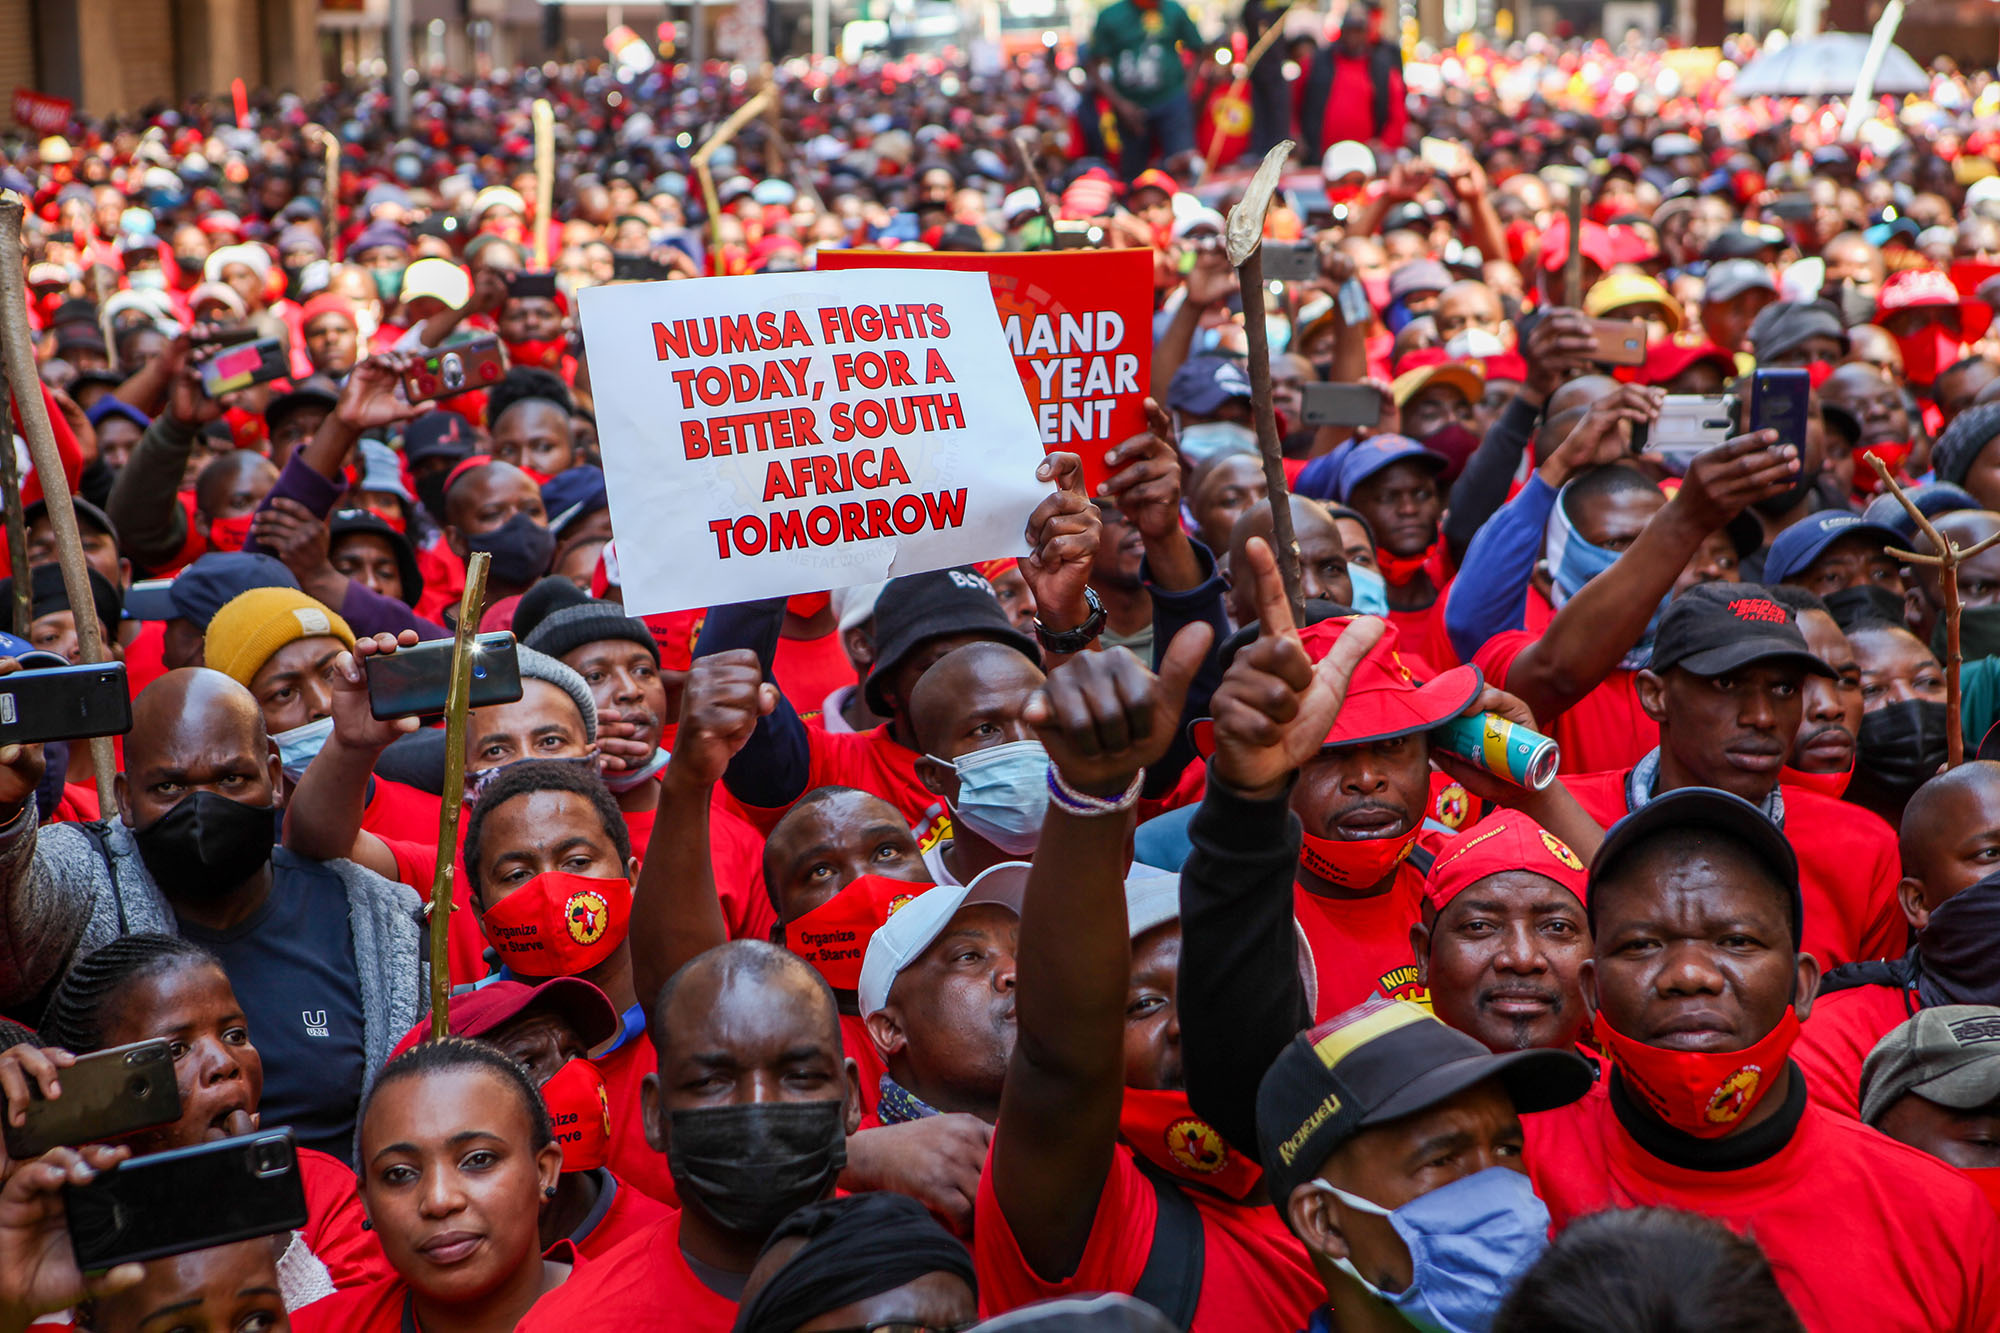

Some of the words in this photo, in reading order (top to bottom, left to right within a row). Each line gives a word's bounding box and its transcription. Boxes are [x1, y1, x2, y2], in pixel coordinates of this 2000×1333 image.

[651, 310, 814, 361] NUMSA
[818, 303, 951, 345] FIGHTS
[671, 357, 824, 409] TODAY,
[833, 350, 918, 392] FOR
[925, 348, 955, 384] A
[1029, 353, 1140, 399] YEAR
[680, 407, 823, 461] BETTER
[830, 393, 966, 442] SOUTH
[1038, 398, 1116, 444] ENT
[763, 447, 911, 502] AFRICA
[709, 488, 968, 559] TOMORROW
[508, 941, 544, 952] Starve
[801, 929, 856, 947] Organize
[819, 948, 861, 961] Starve
